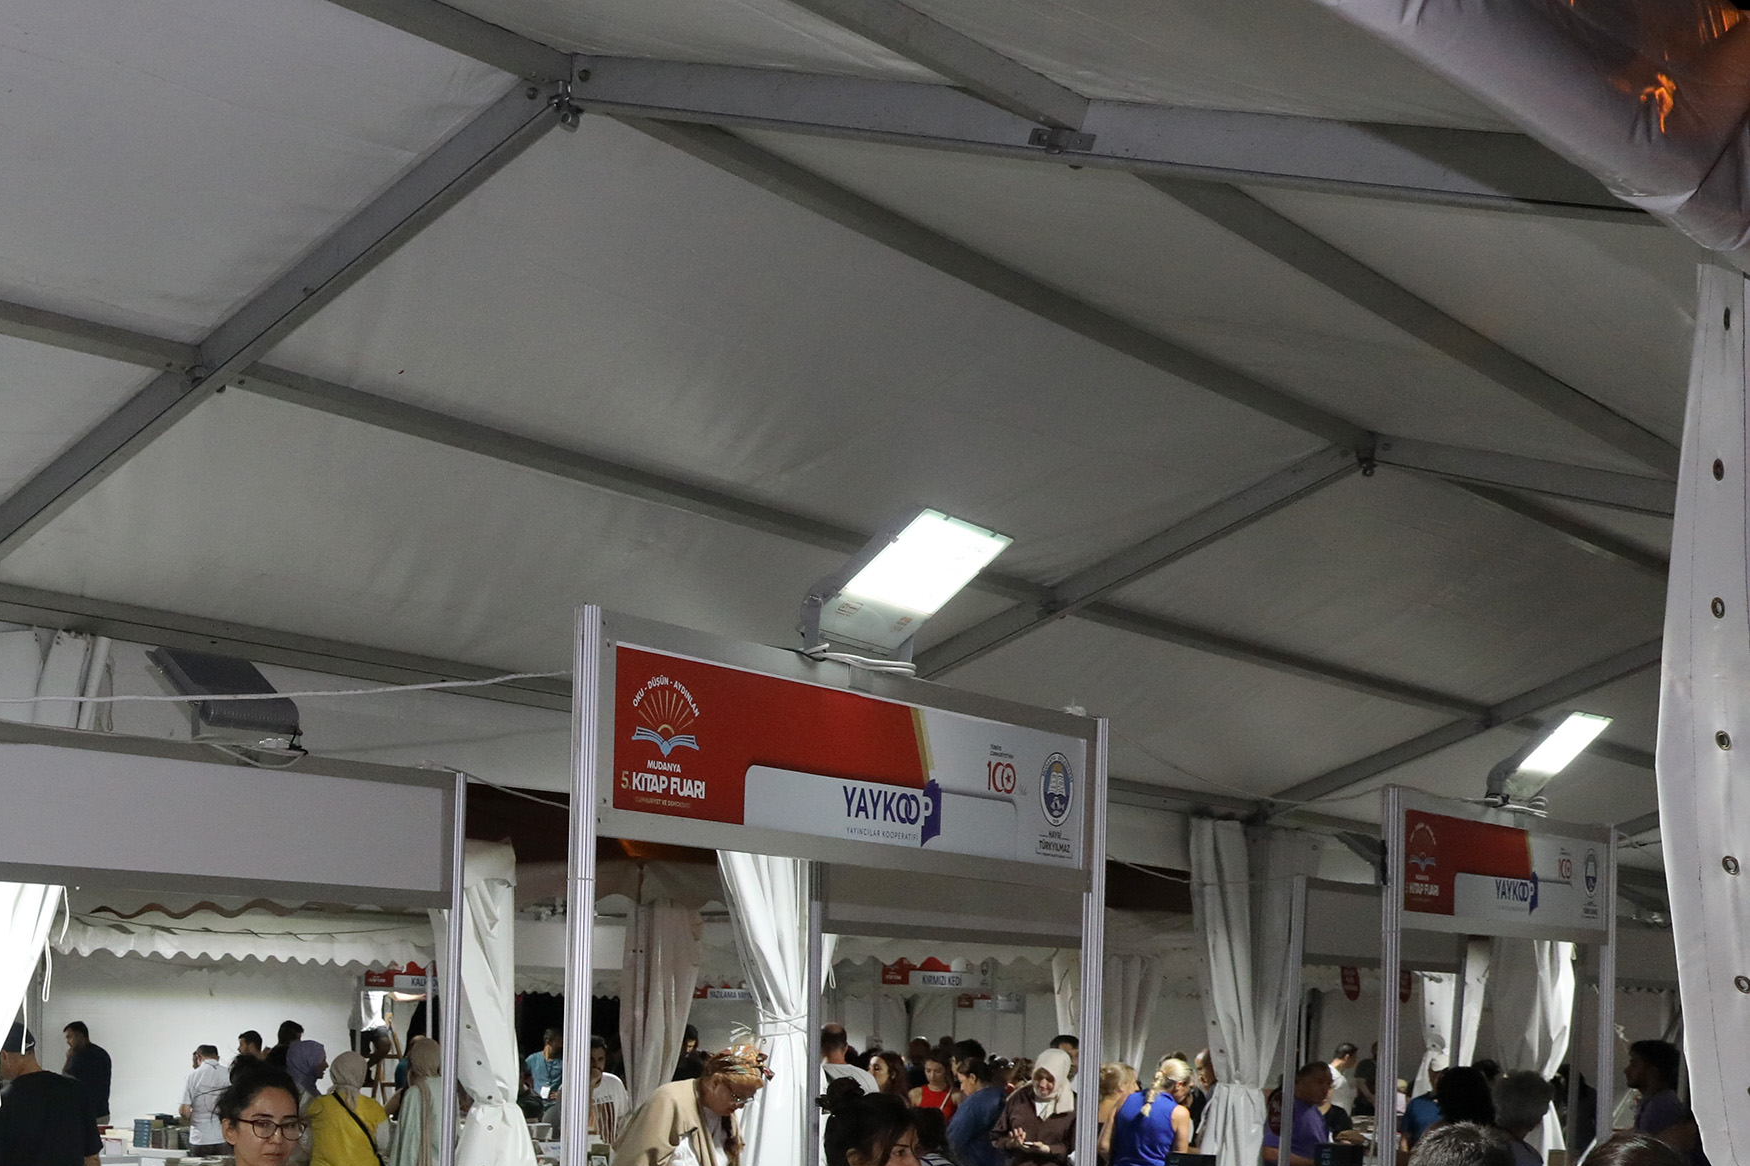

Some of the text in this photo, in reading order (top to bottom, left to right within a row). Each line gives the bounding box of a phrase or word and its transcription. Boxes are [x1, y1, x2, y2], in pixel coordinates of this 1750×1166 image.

[633, 688, 644, 707] OKU
[673, 680, 700, 717] AYDINLAN
[647, 760, 681, 773] MUDANYA
[621, 770, 706, 799] 5. KİTAP FUARI
[842, 785, 934, 827] YAYKOOP
[846, 827, 880, 839] YAYINCILAR
[1039, 839, 1070, 853] TÜRKYILMAZ
[1495, 879, 1534, 902] YAYKOOP
